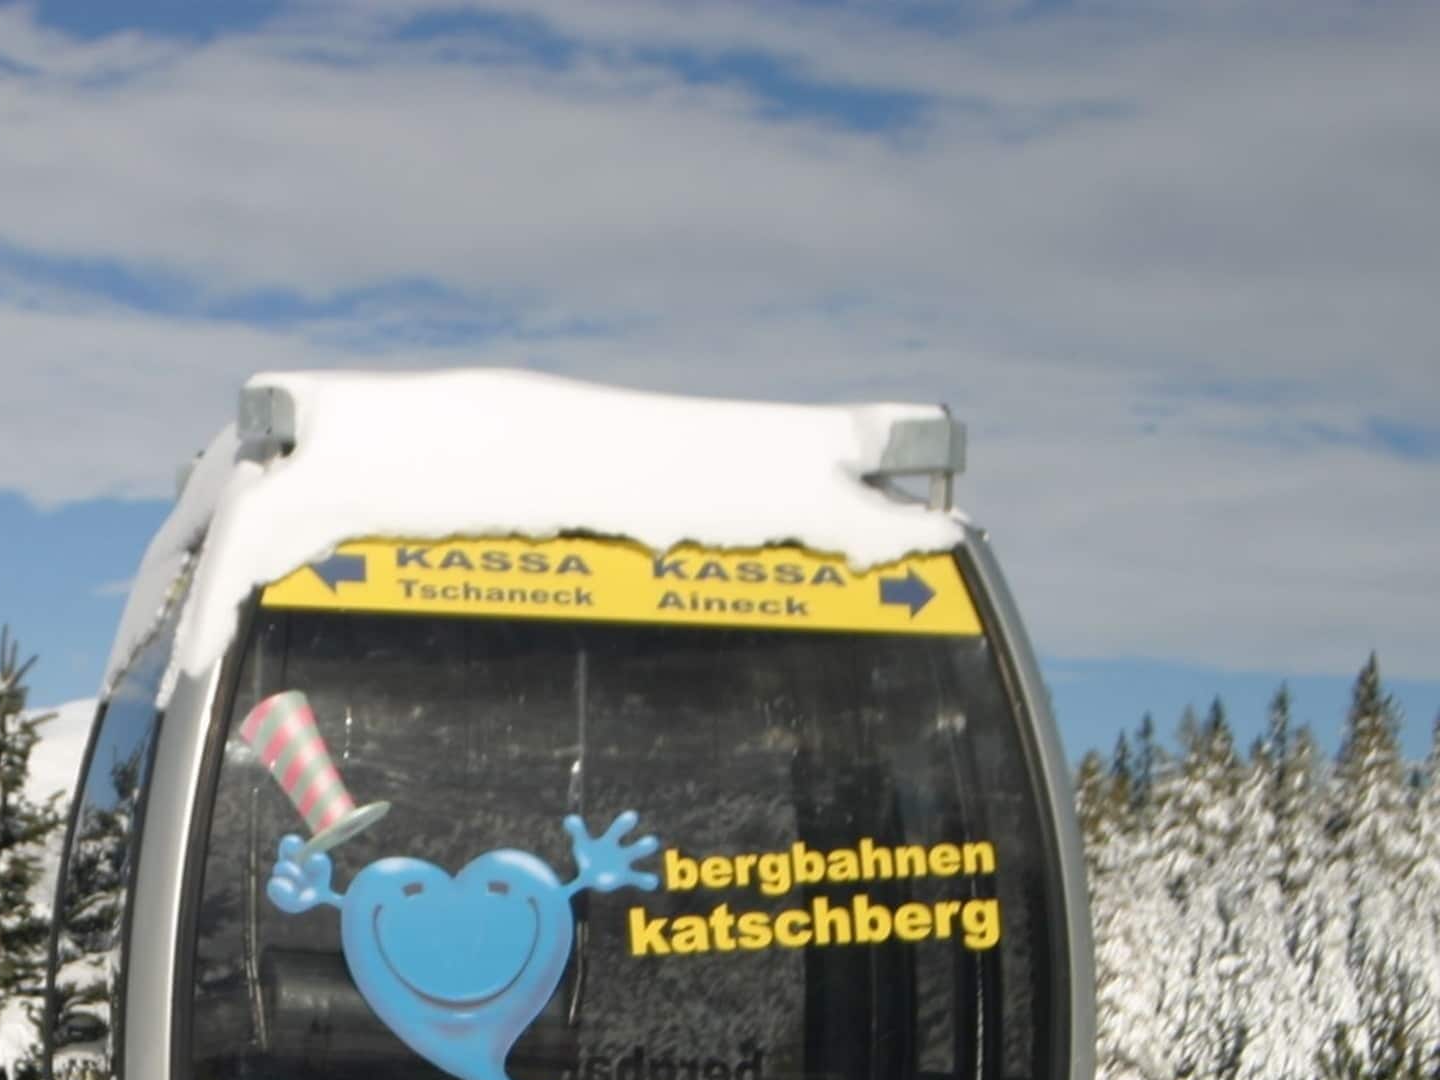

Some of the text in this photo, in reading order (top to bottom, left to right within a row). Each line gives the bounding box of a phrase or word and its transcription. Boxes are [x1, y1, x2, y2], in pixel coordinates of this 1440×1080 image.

[396, 547, 593, 576] KASSA
[652, 557, 846, 587] KASSA
[397, 577, 594, 606] Tschaneck
[656, 591, 809, 617] Aineck
[664, 837, 996, 895] bergbahnen
[628, 894, 1001, 957] katschberg
